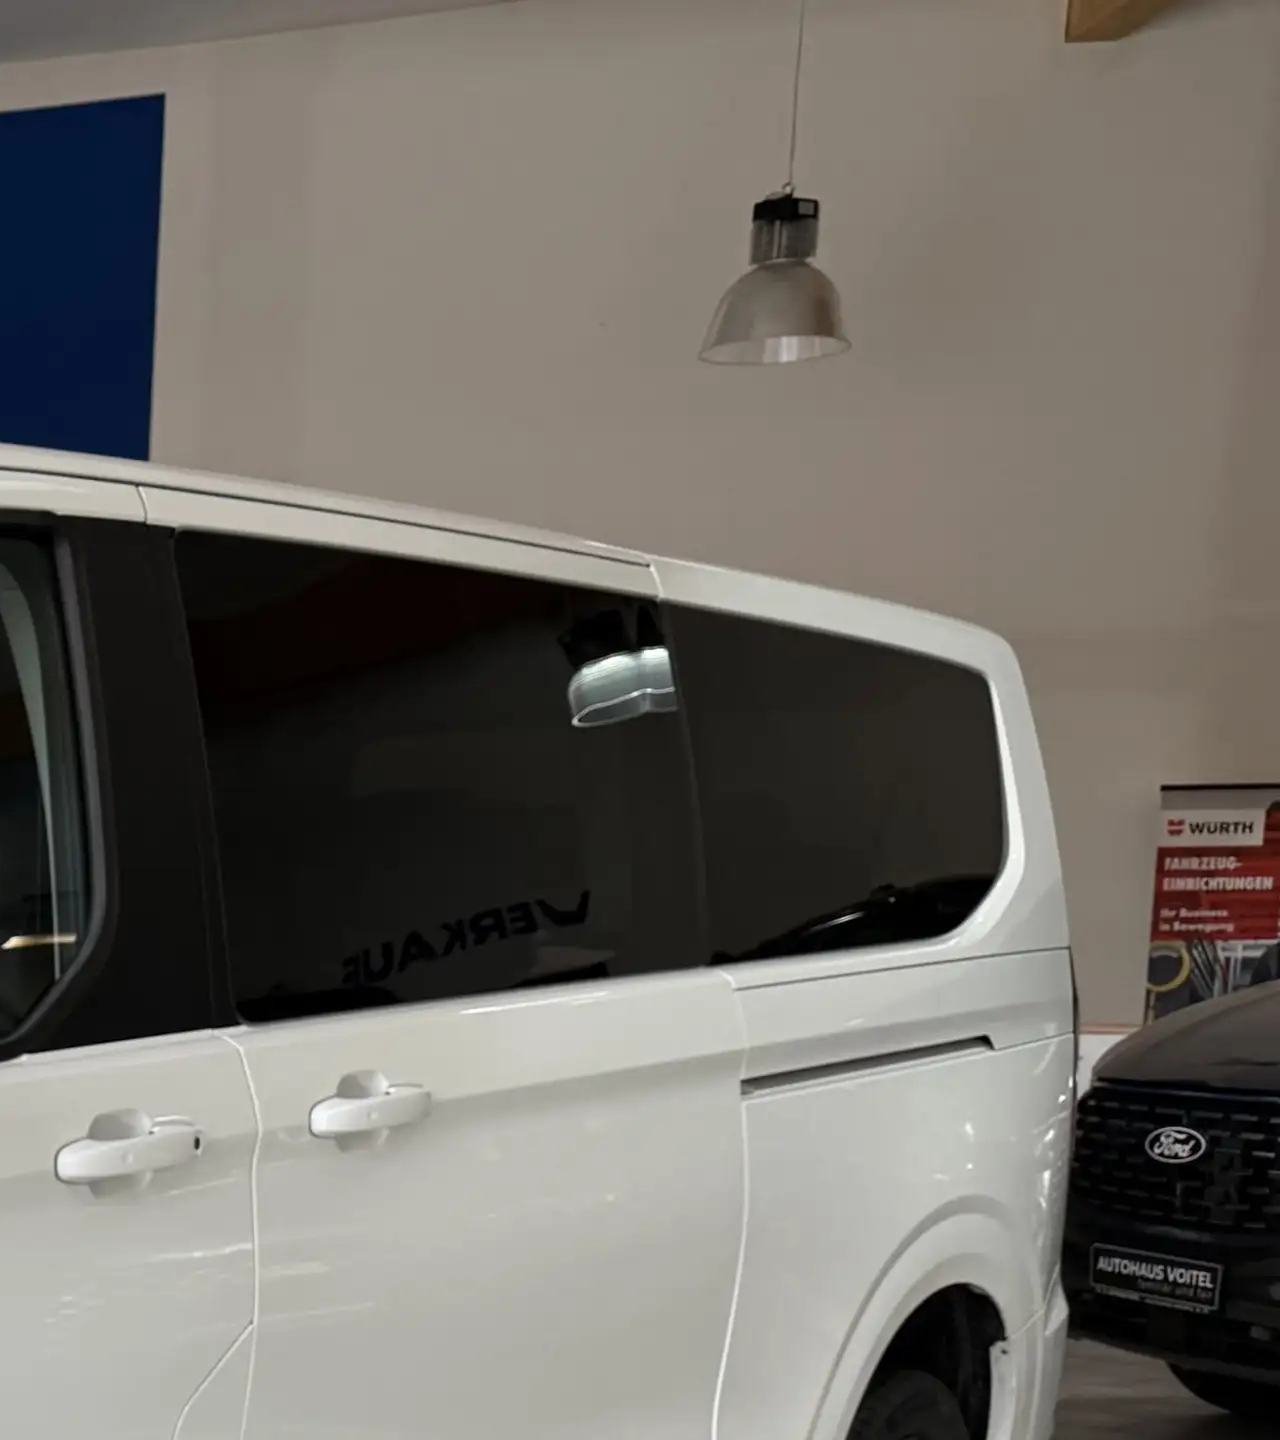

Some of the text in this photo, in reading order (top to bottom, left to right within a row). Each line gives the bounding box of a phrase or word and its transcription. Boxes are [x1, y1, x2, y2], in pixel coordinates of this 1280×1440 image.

[1152, 1129, 1198, 1158] Ford
[1096, 1255, 1215, 1289] AUTOHAUS VOITEL
